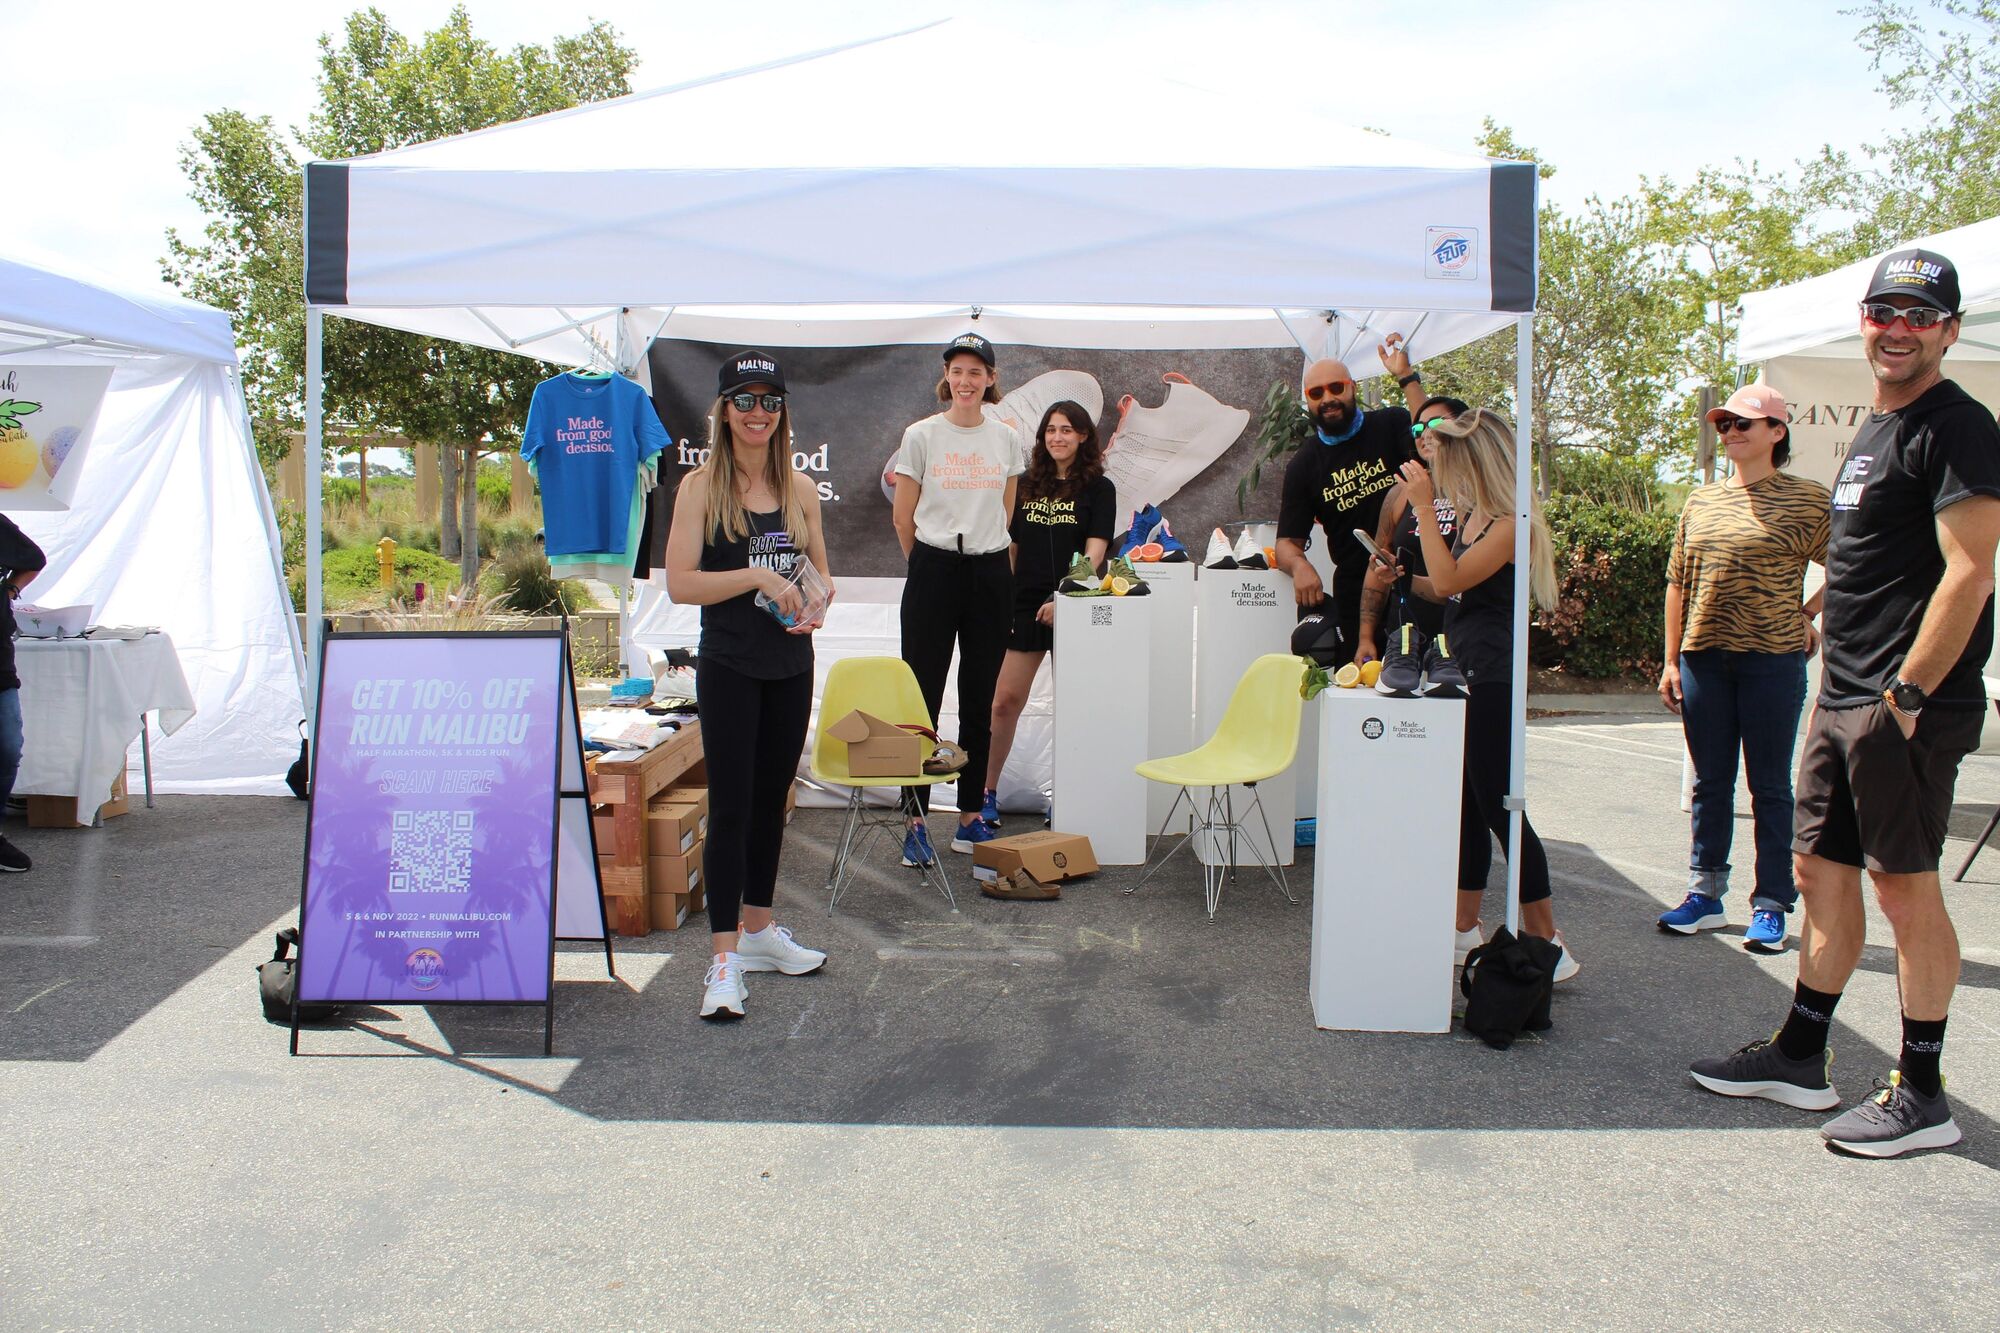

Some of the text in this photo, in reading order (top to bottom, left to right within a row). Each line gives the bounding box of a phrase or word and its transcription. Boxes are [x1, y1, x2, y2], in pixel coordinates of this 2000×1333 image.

[1886, 260, 1942, 278] MALIBU
[1894, 277, 1927, 285] LEGACY
[737, 359, 775, 372] MALIBU
[567, 416, 604, 431] Made
[556, 428, 587, 442] from
[677, 438, 712, 466] fro
[945, 452, 984, 465] Made
[931, 464, 1001, 478] from good
[1331, 460, 1368, 487] Made
[1322, 480, 1358, 502] from
[749, 535, 779, 554] RUN
[1241, 582, 1266, 592] Made
[1231, 589, 1276, 600] from good
[351, 678, 536, 710] GET 10% OFF
[349, 713, 531, 745] RUN MALIBU
[1400, 720, 1419, 728] Made
[356, 749, 380, 757] HALF
[465, 749, 488, 757] KIDS
[490, 748, 510, 757] RUN
[379, 769, 496, 794] SCAN HERE
[345, 912, 511, 921] 5 & 6 NOV 2022 RUNMALIBU.COM
[375, 930, 480, 939] IN PARTNERSHIP WITH
